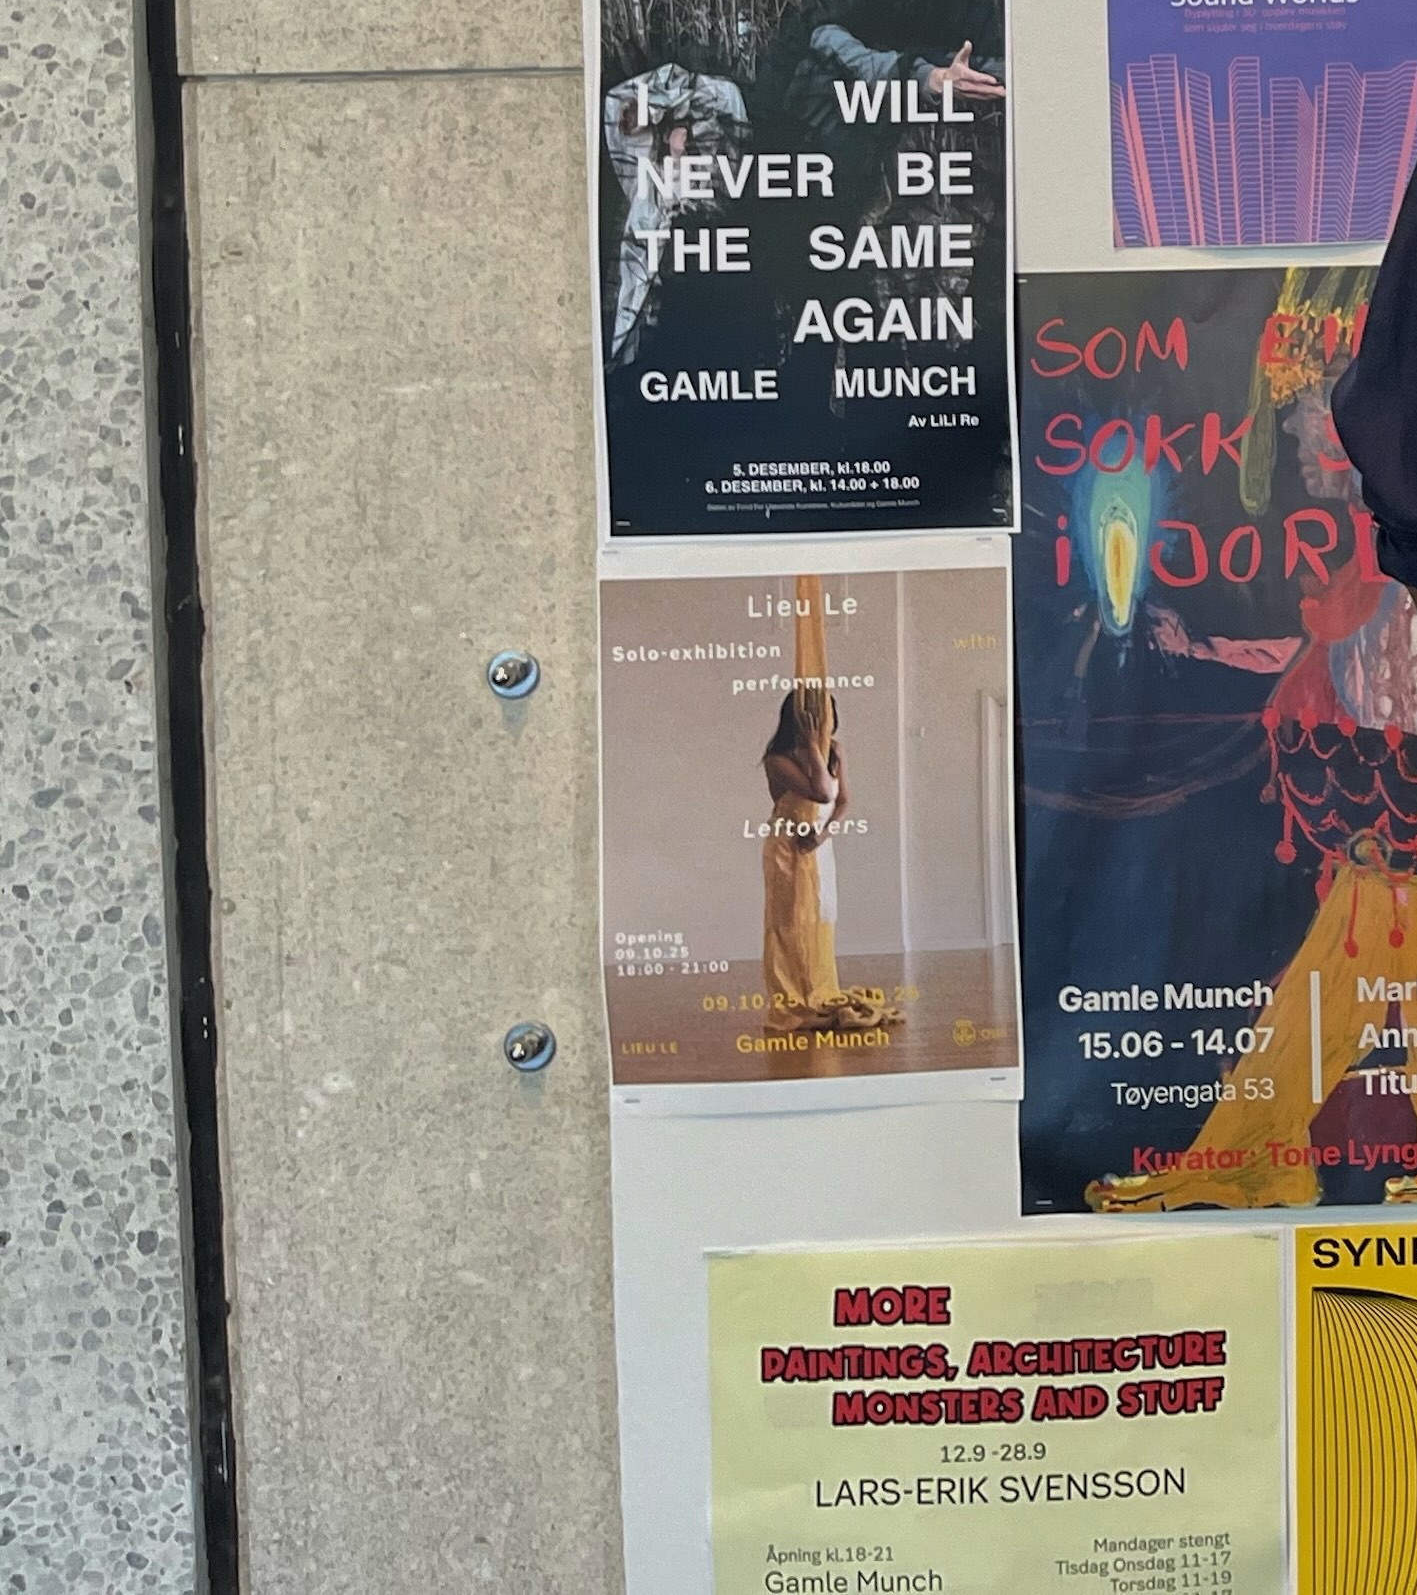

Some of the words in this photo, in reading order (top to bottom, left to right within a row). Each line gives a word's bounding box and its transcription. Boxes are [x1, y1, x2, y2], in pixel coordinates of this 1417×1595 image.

[637, 85, 648, 126] I
[833, 80, 974, 124] WILL
[638, 154, 834, 199] NEVER
[898, 152, 974, 195] BE
[635, 228, 750, 272] THE
[809, 224, 974, 270] SAME
[793, 297, 973, 343] AGAIN
[1031, 318, 1188, 379] SOM
[640, 370, 778, 401] GAMLE
[835, 367, 976, 397] MUNCH
[1036, 413, 1255, 475] SOKK
[748, 596, 810, 617] Lieu
[824, 595, 857, 615] Le
[612, 643, 781, 662] Solo-exhibition
[732, 672, 874, 694] performance
[744, 817, 868, 840] Leftovers
[1059, 985, 1159, 1013] Gamle
[1164, 981, 1273, 1010] Munch
[737, 1033, 809, 1053] Gamle
[816, 1029, 889, 1049] Munch
[834, 1285, 951, 1327] MORE
[761, 1344, 957, 1383] PAINTINGS,
[968, 1331, 1226, 1377] ARCHITECTURE
[832, 1387, 1024, 1427] MONSTERS
[1032, 1383, 1109, 1421] AND
[1117, 1377, 1224, 1416] STUFF
[815, 1478, 988, 1508] LARS-ERIK
[1000, 1468, 1186, 1505] SVENSSON
[1093, 1534, 1175, 1555] Mandager
[1178, 1531, 1230, 1551] stengt
